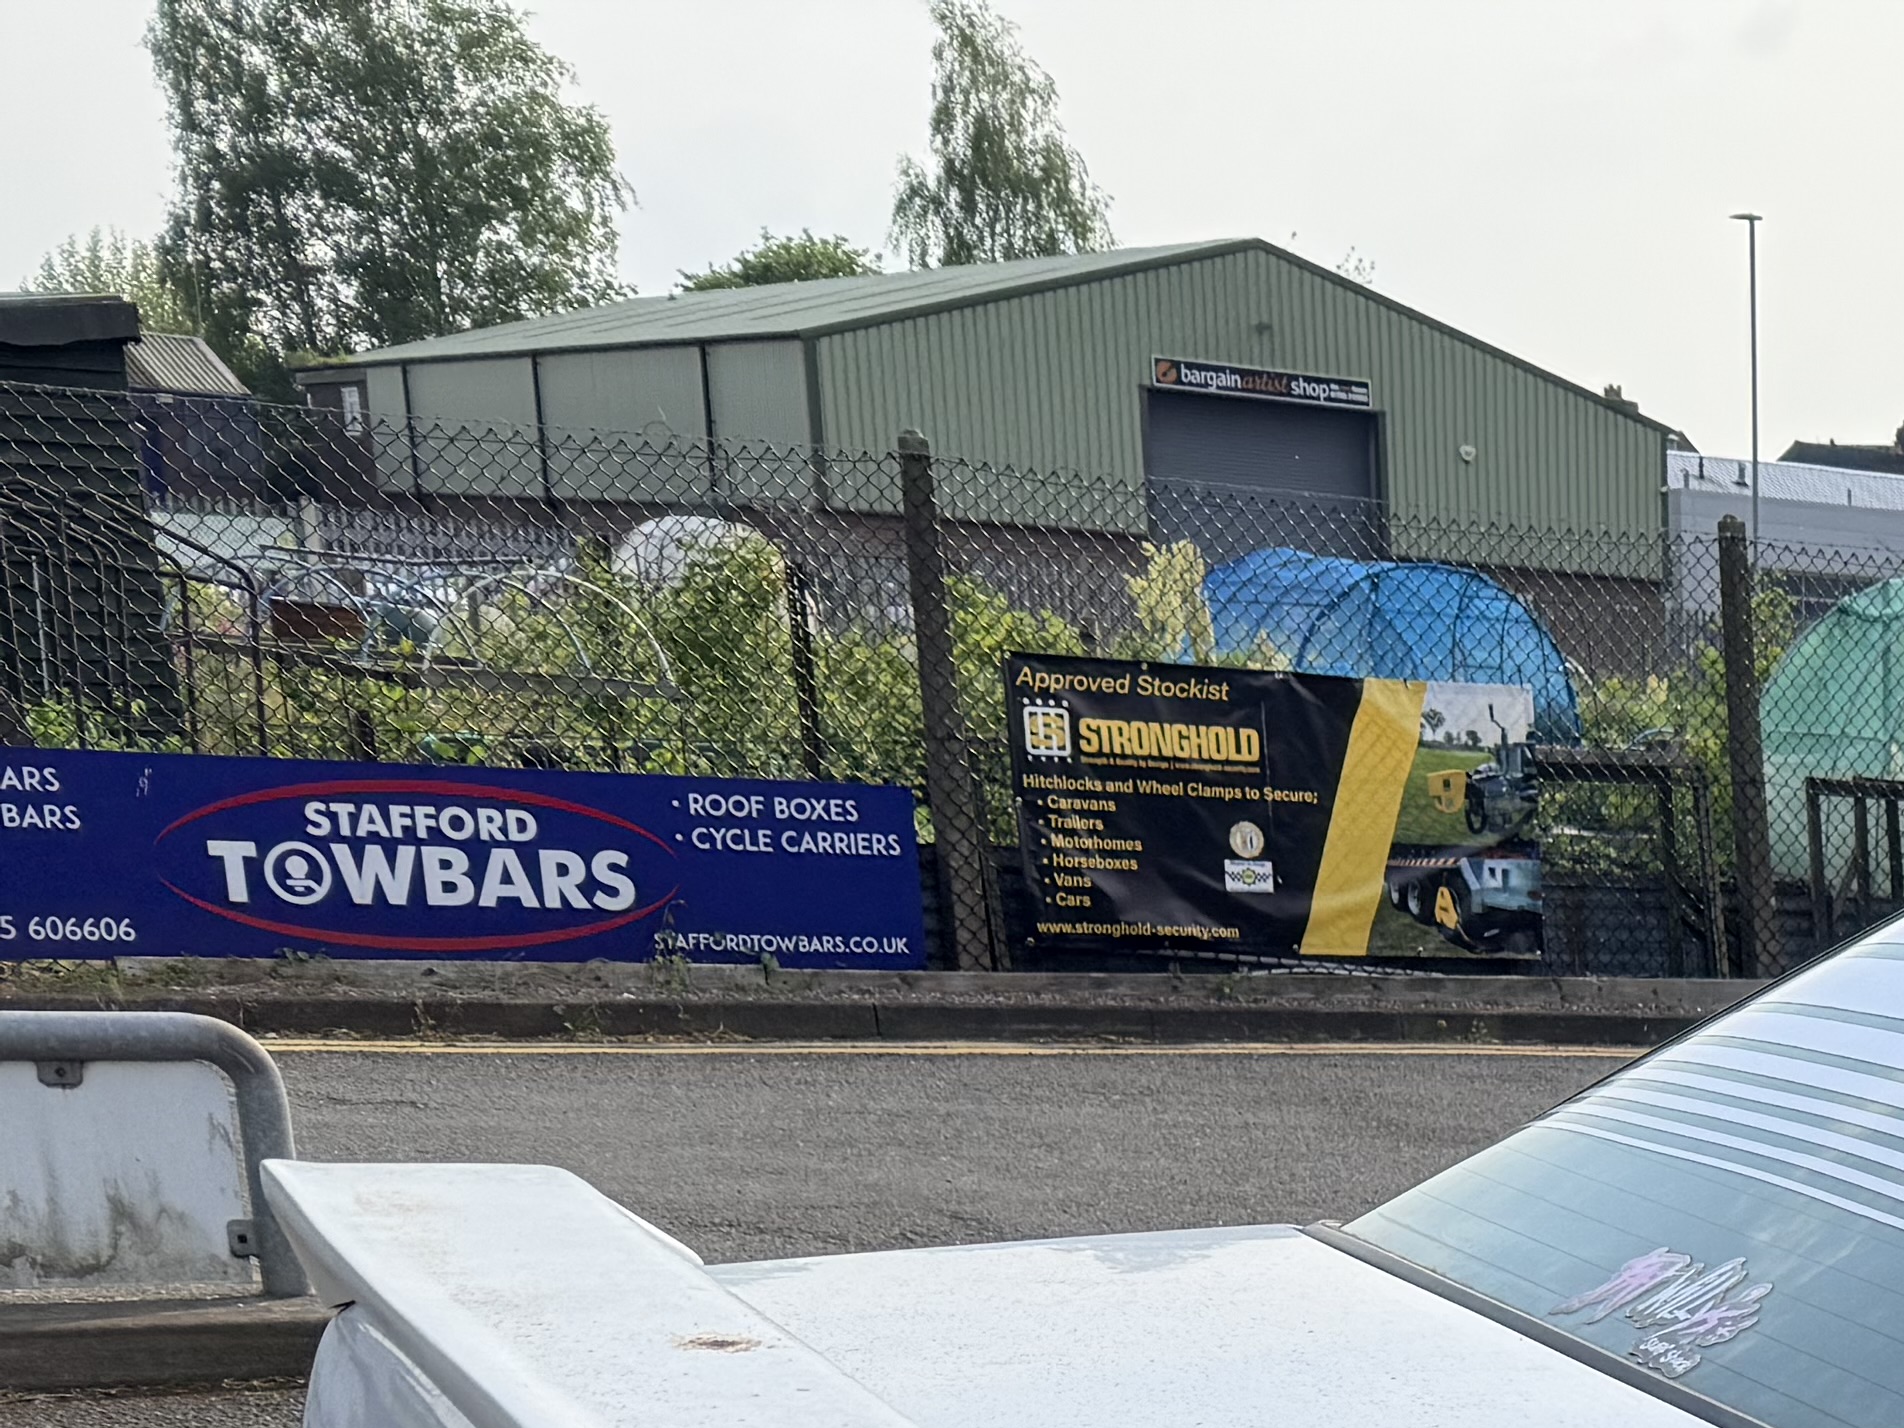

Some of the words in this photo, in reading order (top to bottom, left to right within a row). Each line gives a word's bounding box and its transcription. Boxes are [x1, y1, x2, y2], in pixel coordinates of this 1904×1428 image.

[1181, 364, 1242, 390] bargain
[1243, 371, 1288, 394] artist
[1290, 377, 1330, 401] shop
[1016, 666, 1131, 694] Approved
[1137, 674, 1230, 702] Stockist
[1079, 717, 1260, 762] STRONGHOLD
[0, 766, 60, 792] ARS
[1023, 773, 1102, 793] Hitchlocks
[1105, 778, 1133, 794] and
[1136, 779, 1184, 797] Wheel
[1187, 782, 1242, 802] Clamps
[1244, 785, 1260, 800] to
[1, 803, 81, 830] BARS
[688, 793, 764, 818] ROOF
[774, 797, 859, 822] BOXES
[1047, 796, 1116, 812] Caravans
[304, 801, 538, 843] STAFFORD
[1048, 813, 1104, 831] Trailers
[691, 827, 774, 852] CYCLE
[781, 831, 901, 856] CARRIERS
[1051, 834, 1143, 852] Motorhomes
[207, 839, 637, 912] TOWBARS
[1053, 854, 1139, 871] Horseboxes
[1054, 873, 1092, 889] Vans
[1055, 893, 1092, 907] Cars
[28, 916, 137, 942] 606606
[1036, 920, 1240, 941] www.stronghold-security.com
[654, 932, 910, 954] STAFFORDTOWBARS.CO.UK
